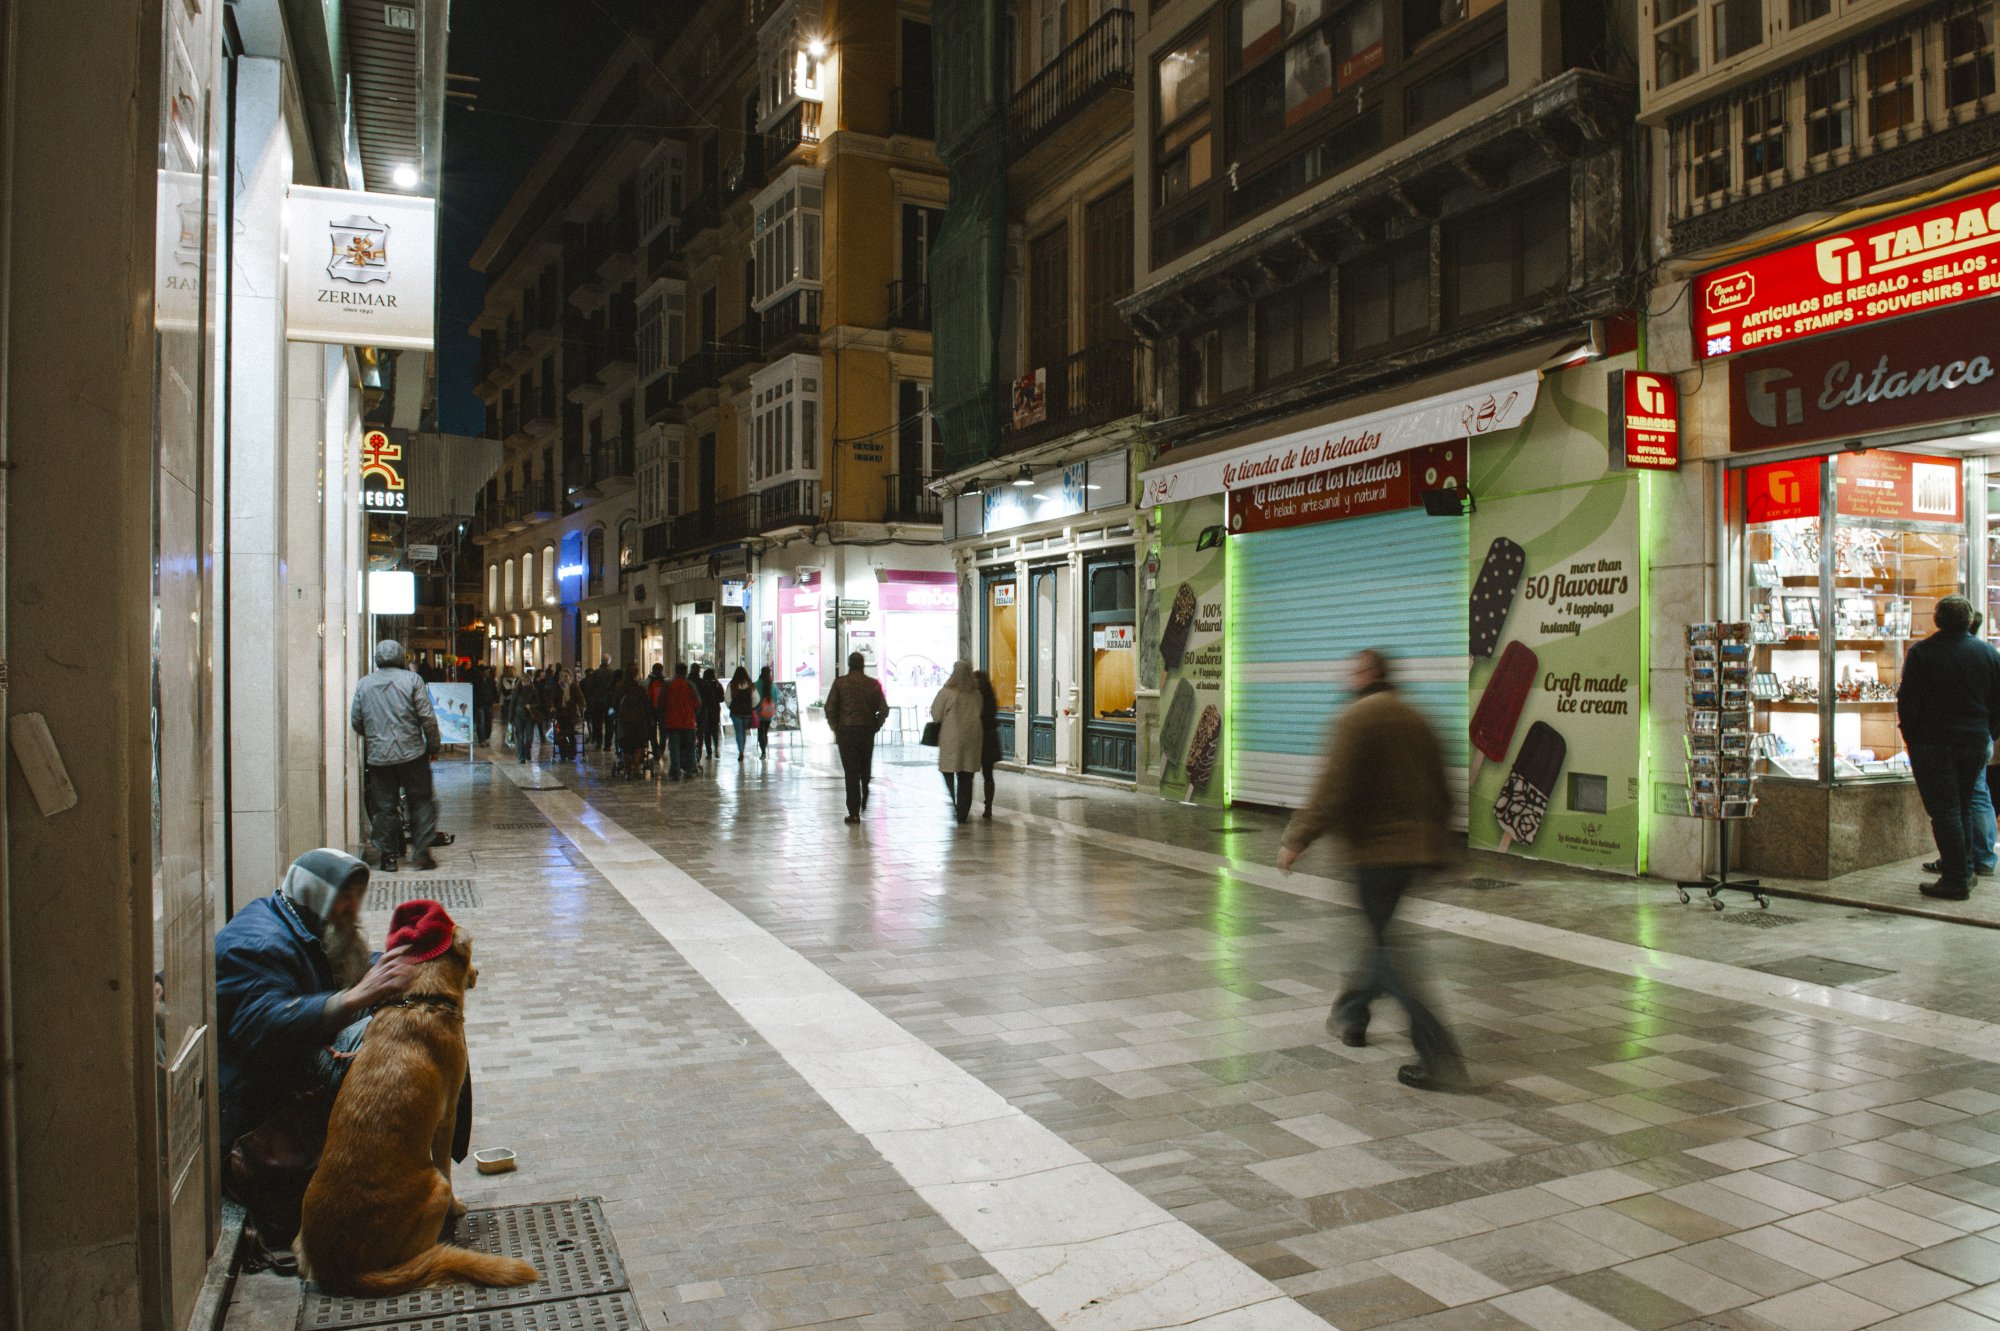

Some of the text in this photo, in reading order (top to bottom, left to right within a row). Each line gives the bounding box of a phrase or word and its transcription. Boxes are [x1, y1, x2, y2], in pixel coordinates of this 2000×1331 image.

[1736, 278, 1746, 291] de
[1742, 255, 1987, 328] ARTÍCULOS DE REGALO SELLOS
[317, 289, 399, 308] ZERIMAR
[1718, 293, 1742, 306] Puros
[1742, 325, 1783, 346] GIFTS
[1794, 308, 1854, 334] STAMPS
[1866, 281, 1963, 316] SOUVENIRS
[1817, 353, 1994, 411] Estanco
[1626, 415, 1676, 429] TABACOS
[1637, 445, 1666, 455] OFFICIAL
[1222, 430, 1382, 490] La tienda de los helados
[1628, 455, 1676, 465] TOBACCO SHOP
[1253, 458, 1402, 511] La tienda de los helados
[1264, 484, 1388, 520] el helado artesanal y natural
[1570, 558, 1622, 574] more than
[1525, 573, 1628, 605] 50 flavours
[1202, 603, 1222, 618] 100%
[1565, 602, 1572, 615] 4
[1573, 601, 1614, 618] toppings
[1110, 630, 1119, 638] YO
[1193, 619, 1222, 633] Natural
[1540, 620, 1581, 636] instantly
[1106, 640, 1132, 648] REBAJAS
[1184, 651, 1222, 665] 50 sabores
[1202, 668, 1222, 679] toppings
[1196, 681, 1221, 690] al instante
[1544, 672, 1628, 697] Craft made
[1557, 693, 1628, 715] ice cream
